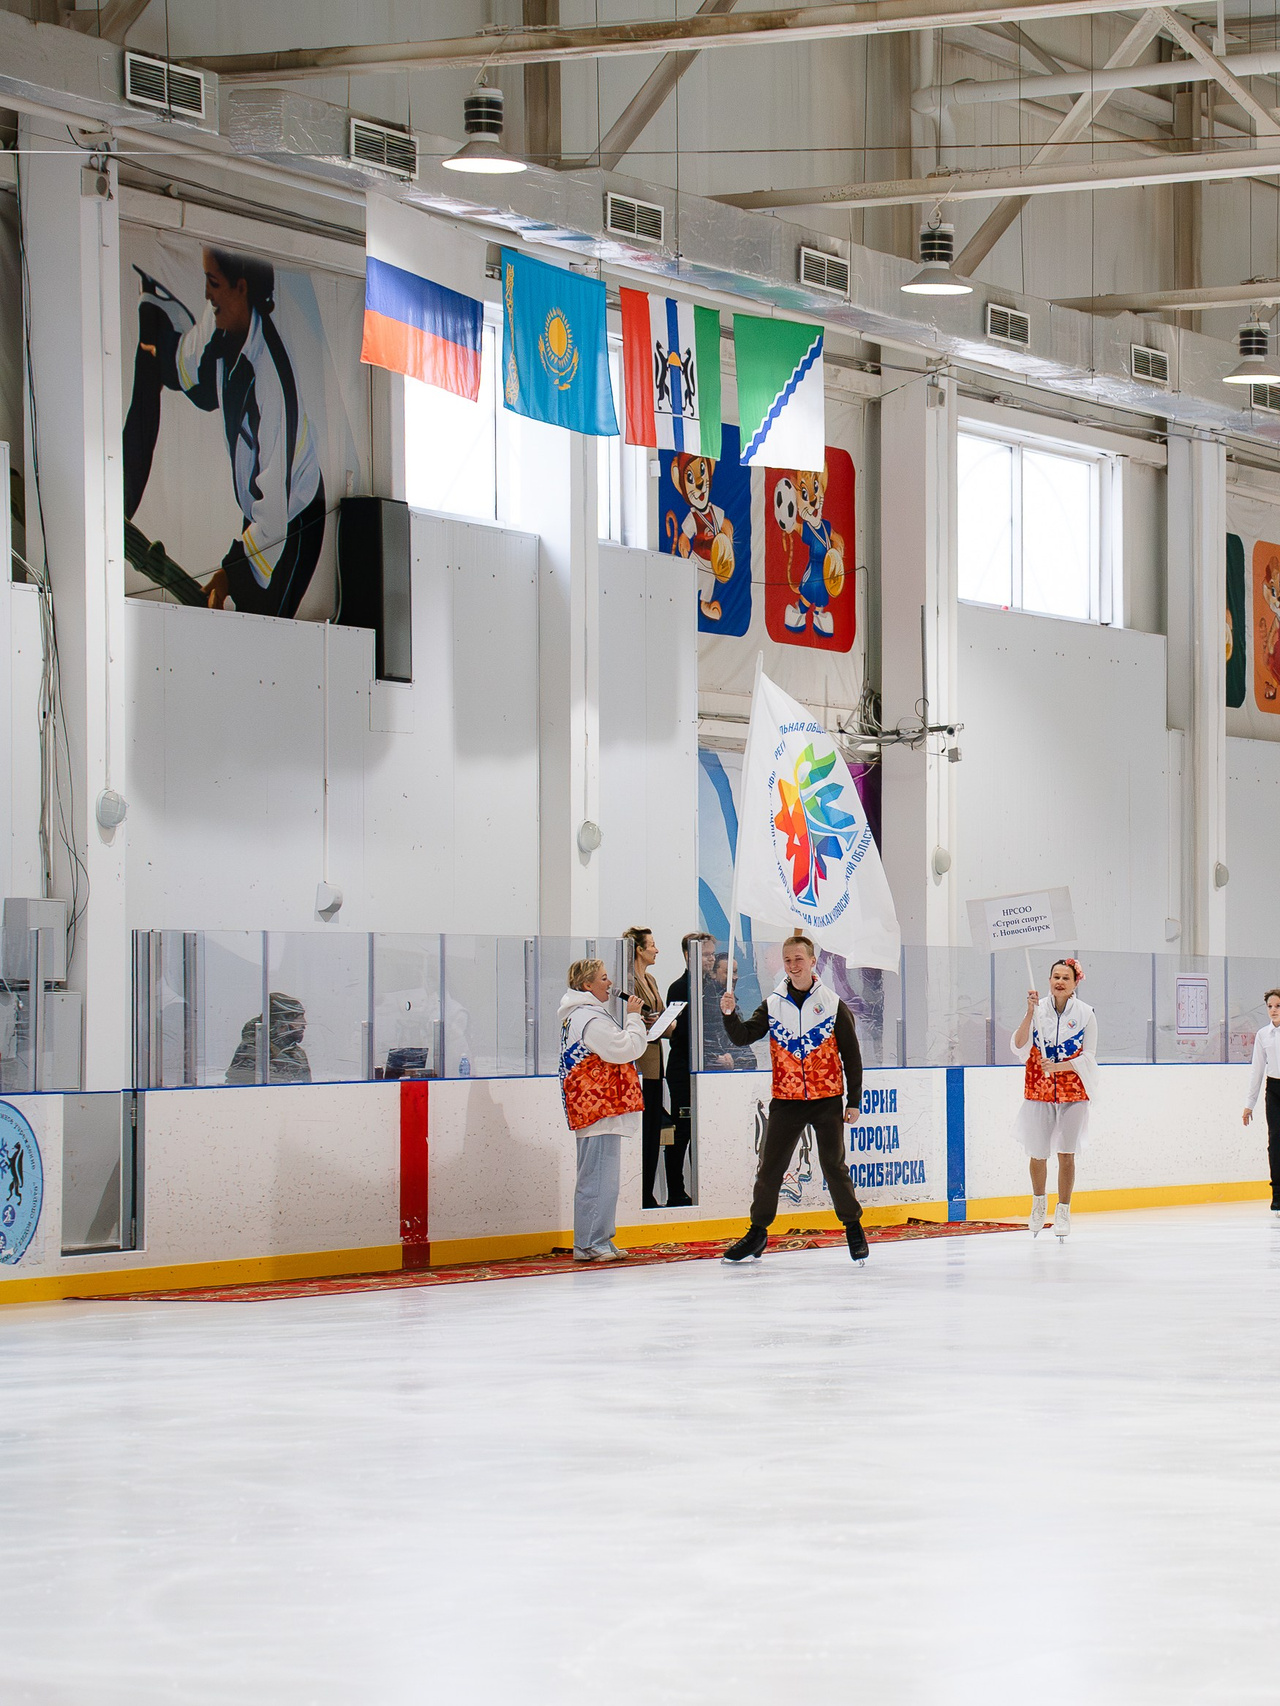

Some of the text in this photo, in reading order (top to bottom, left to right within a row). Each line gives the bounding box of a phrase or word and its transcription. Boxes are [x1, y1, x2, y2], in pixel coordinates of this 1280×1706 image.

[992, 914, 1048, 929] «Строй спорт»
[1002, 905, 1032, 917] НРСОО
[1000, 924, 1051, 937] Новосибирск
[859, 1088, 898, 1115] ЭРИЯ
[850, 1124, 900, 1154] ГОРОДА
[822, 1159, 927, 1191] ОСИБИРСКА
